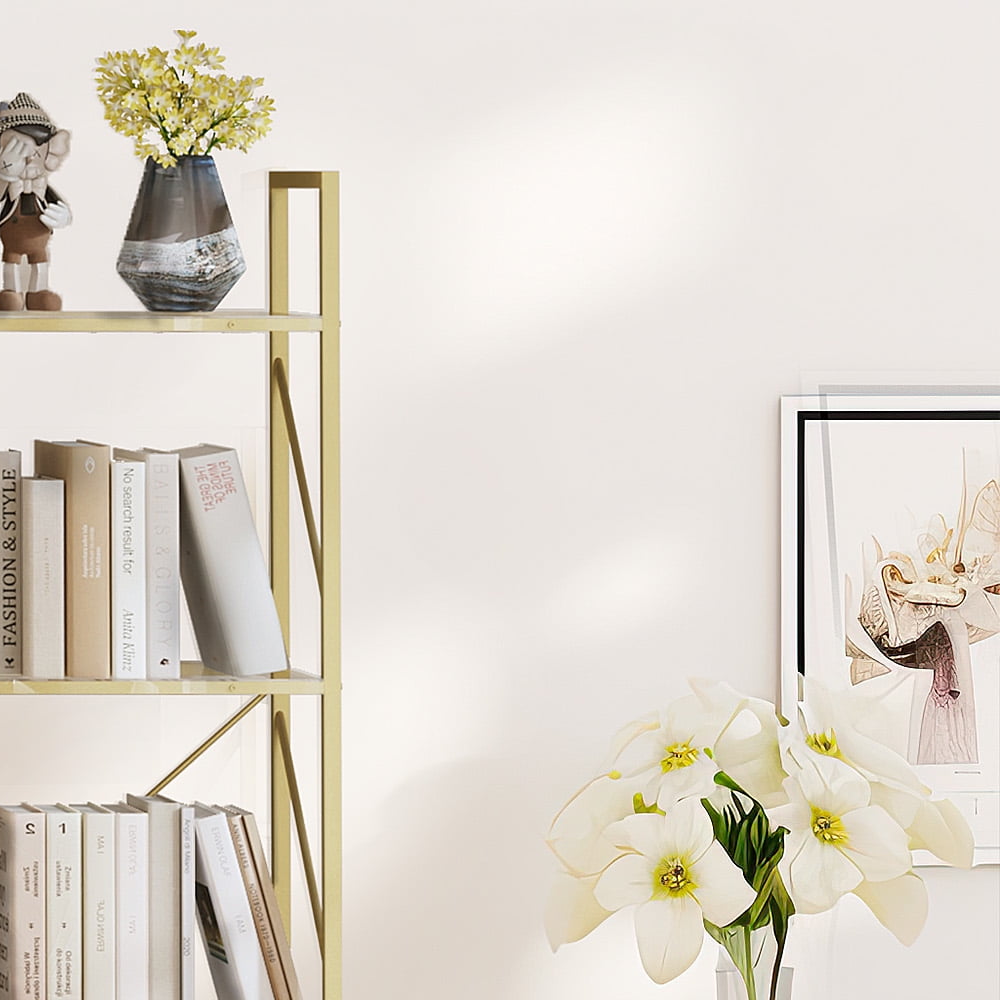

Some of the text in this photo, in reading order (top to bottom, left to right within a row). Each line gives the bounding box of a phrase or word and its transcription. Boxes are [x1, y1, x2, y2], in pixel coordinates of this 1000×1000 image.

[2, 469, 17, 647] FASHION & STYLE
[122, 468, 134, 575] No search result for
[122, 608, 135, 672] Anita Klinz
[58, 823, 65, 834] 1
